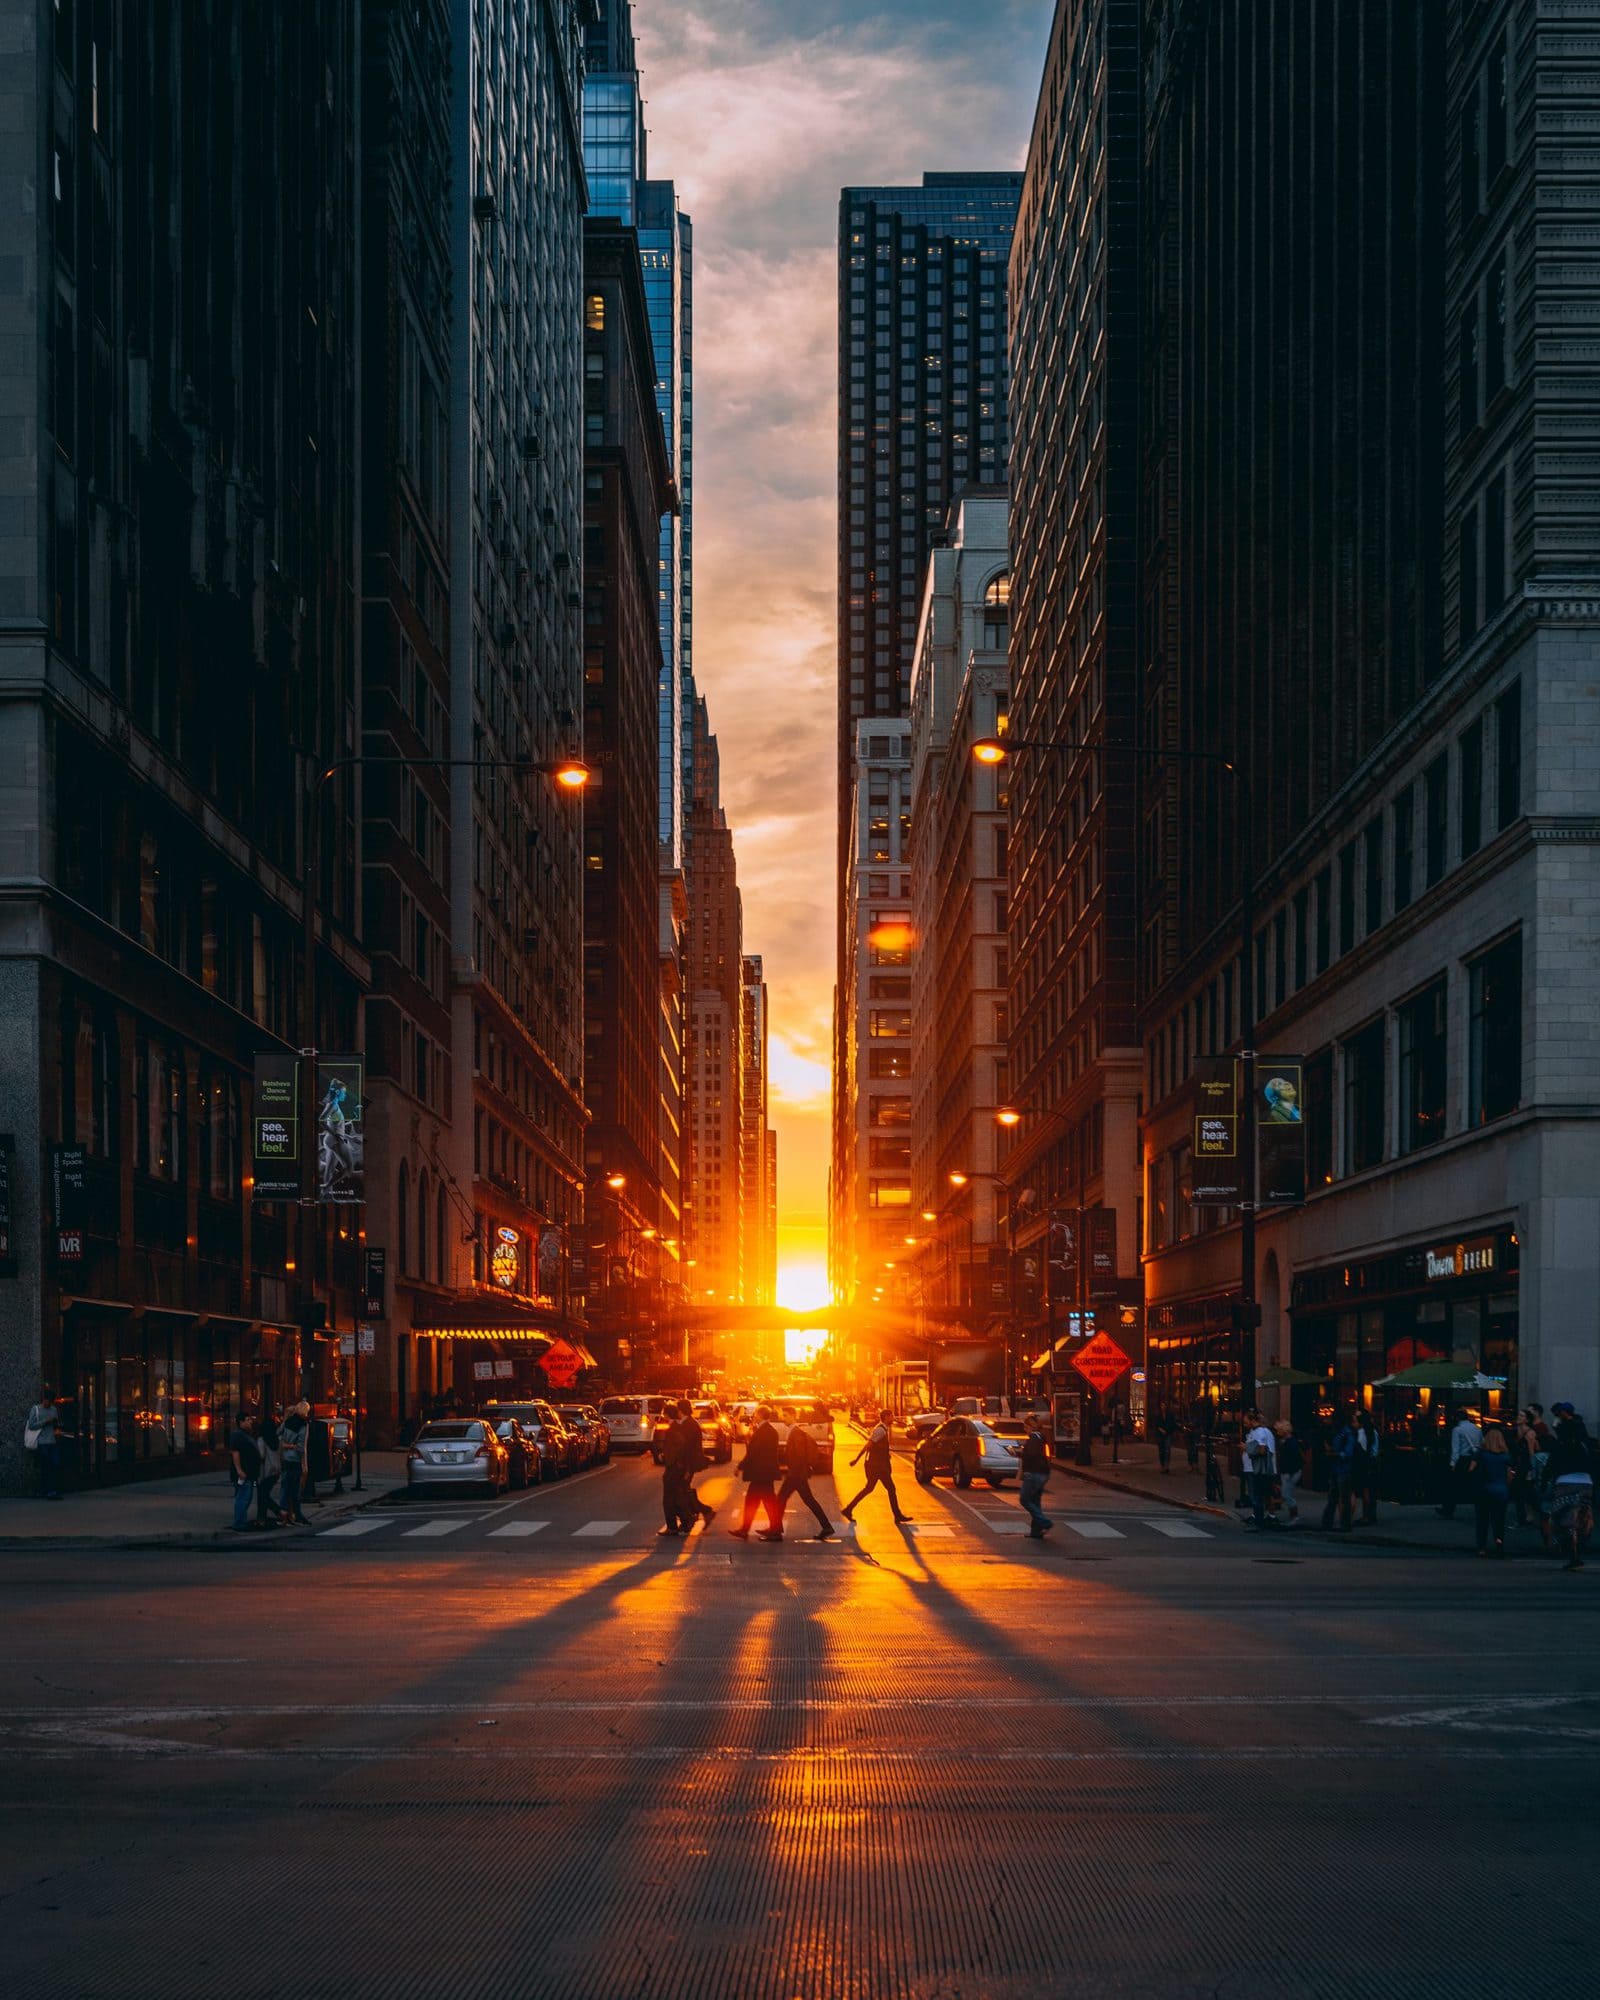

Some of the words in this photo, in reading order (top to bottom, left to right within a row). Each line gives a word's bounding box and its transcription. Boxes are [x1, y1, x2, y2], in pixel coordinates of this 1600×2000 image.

[261, 1094, 290, 1102] Company
[262, 1122, 285, 1131] see.
[1202, 1120, 1225, 1129] see.
[262, 1132, 289, 1142] hear.
[1202, 1130, 1229, 1140] hear.
[262, 1142, 285, 1152] feel.
[1202, 1140, 1225, 1151] feel.
[60, 1238, 80, 1252] MR
[1092, 1346, 1112, 1354] ROAD
[1075, 1357, 1129, 1366] CONSTRUCTION
[549, 1363, 575, 1371] AHEAD
[1090, 1369, 1116, 1377] AHEAD
